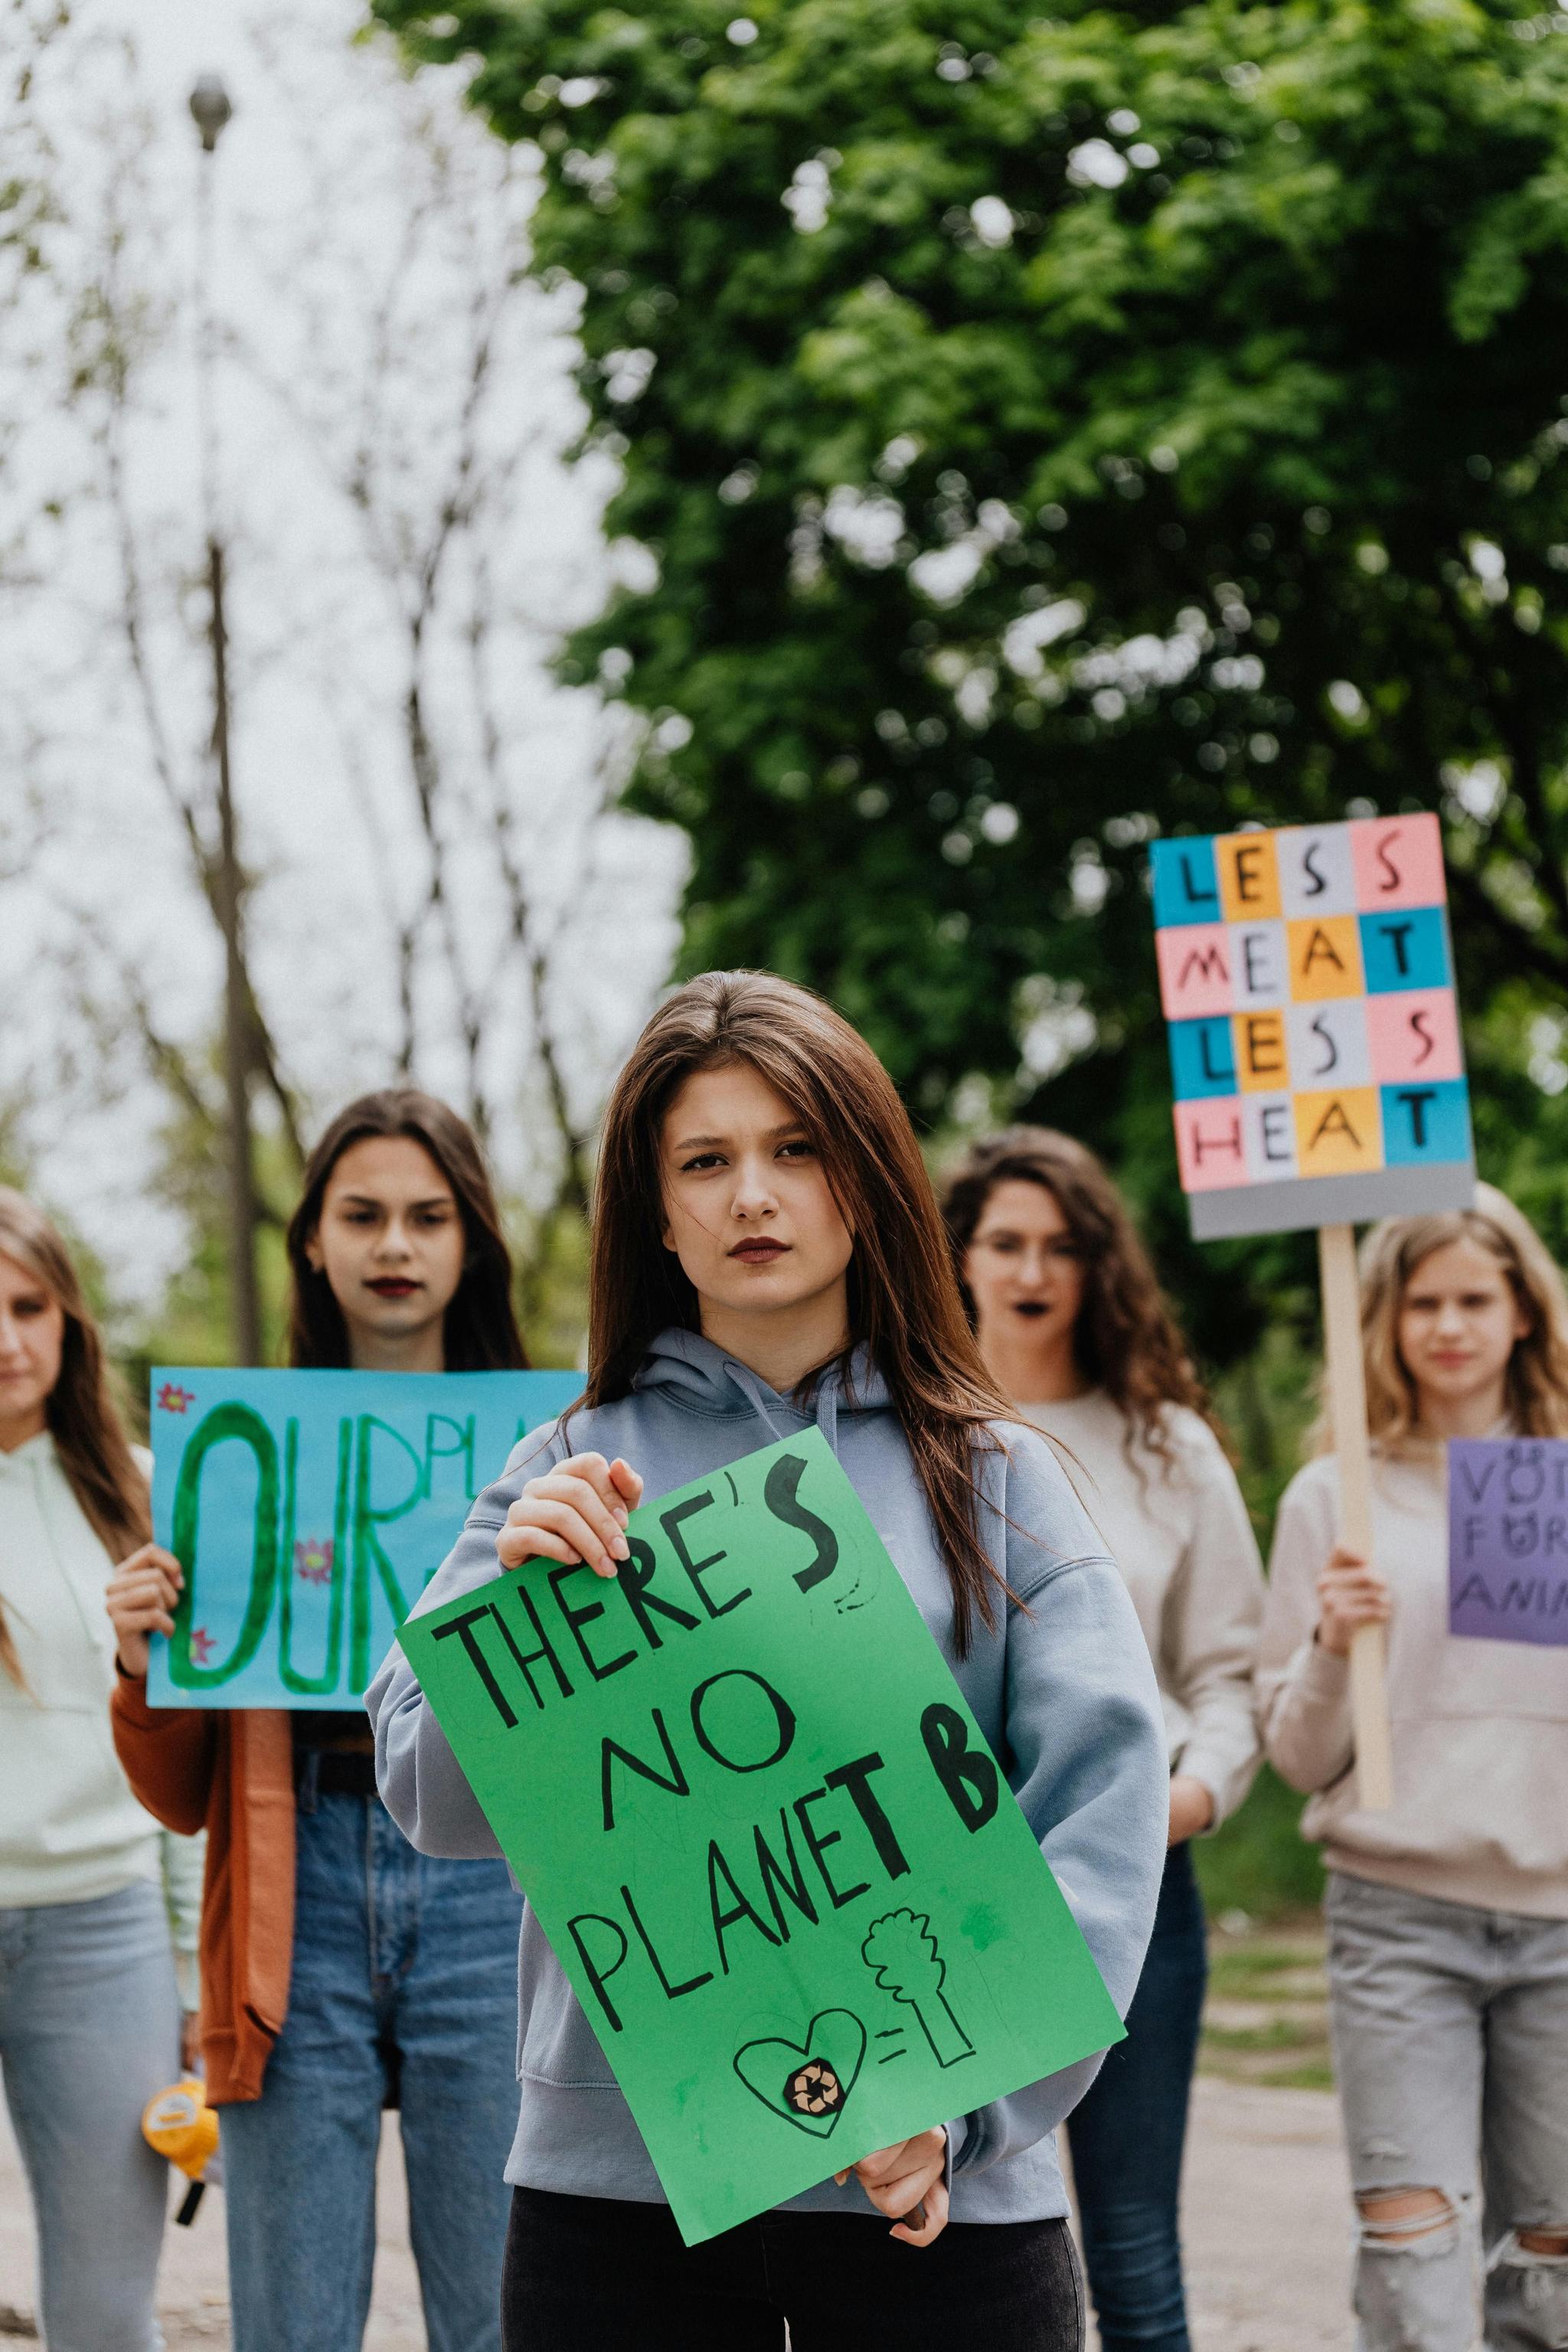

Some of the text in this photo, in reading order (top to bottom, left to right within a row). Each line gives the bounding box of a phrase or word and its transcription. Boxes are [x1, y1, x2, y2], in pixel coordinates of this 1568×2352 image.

[1181, 829, 1402, 903] LESS
[1178, 923, 1413, 991] MEAT
[1200, 1009, 1434, 1081] LESS
[1192, 1089, 1436, 1166] HEAT
[168, 1400, 426, 1695] OUR
[430, 1453, 839, 1729] THERE'S
[601, 1668, 797, 1831] NO
[567, 1702, 1000, 2032] PLANET B
